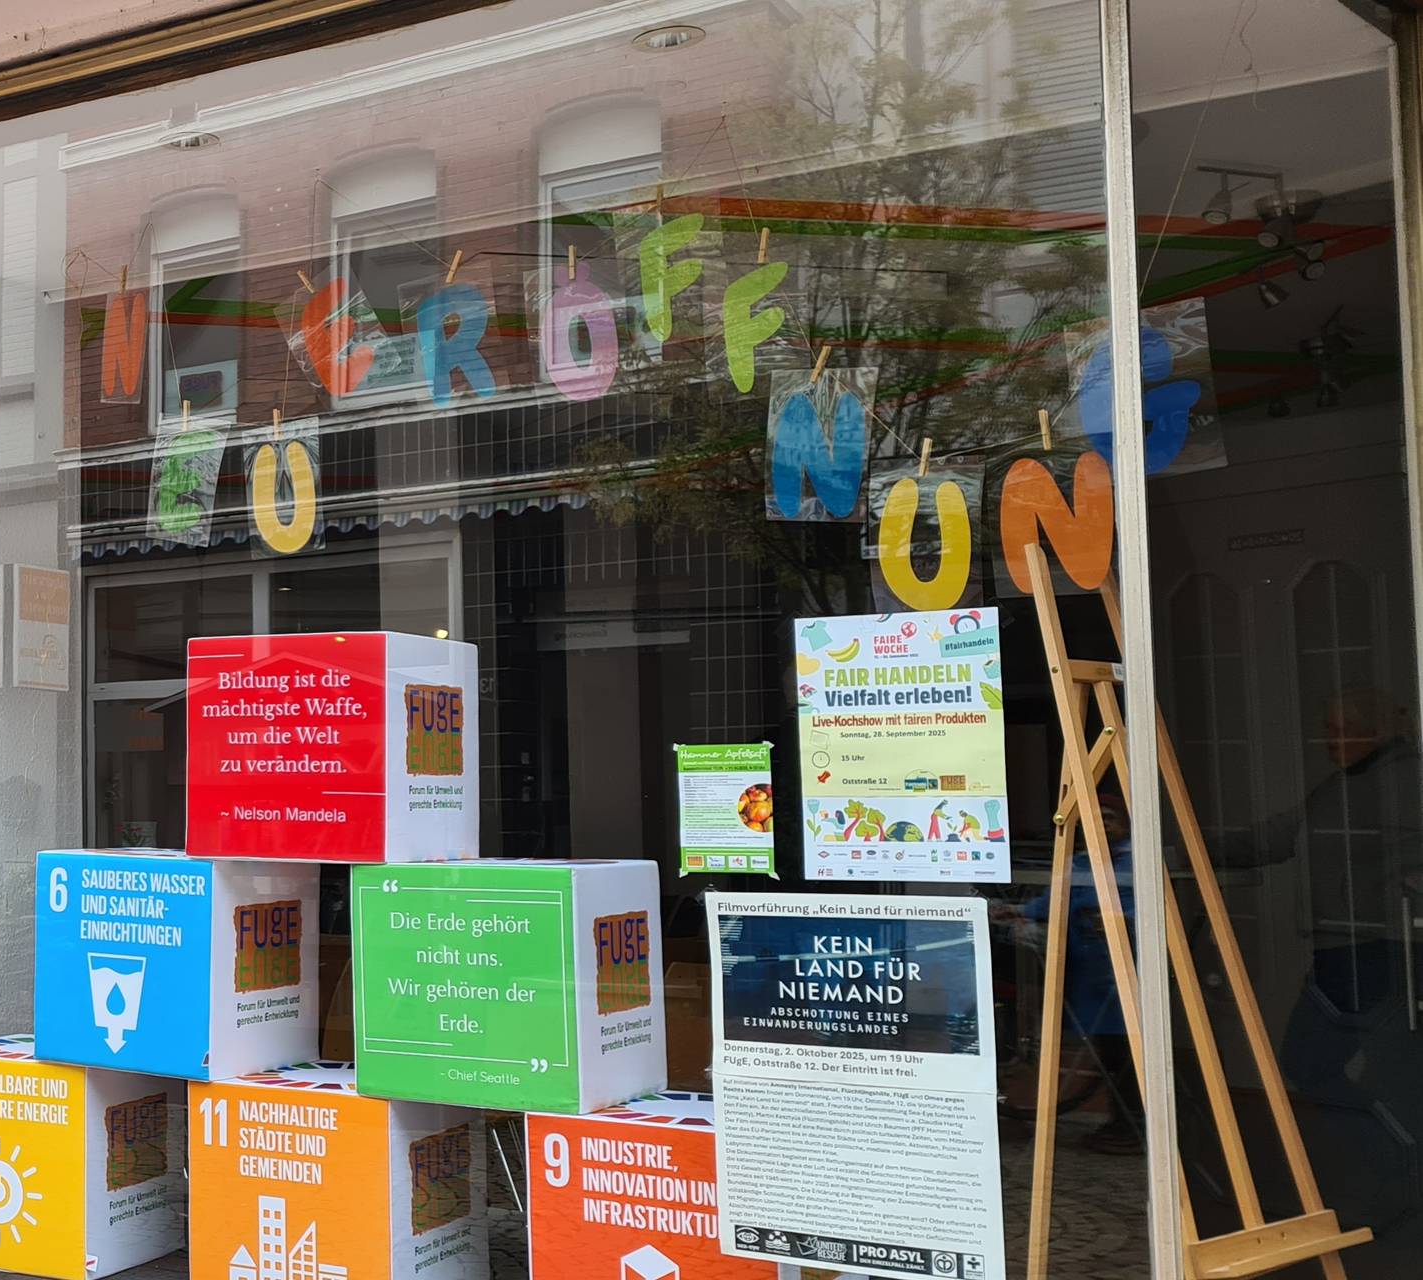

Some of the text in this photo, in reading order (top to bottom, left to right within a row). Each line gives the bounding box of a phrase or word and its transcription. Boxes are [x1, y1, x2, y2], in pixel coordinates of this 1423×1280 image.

[873, 635, 902, 645] FAIRE
[874, 644, 909, 654] WOCHE
[944, 638, 994, 651] #fairhandeln
[218, 671, 350, 692] Bildung ist die
[824, 663, 972, 687] FAIR HANDELN
[825, 685, 972, 708] Vielfalt erleben!
[202, 697, 367, 720] mächtigste Waffe,
[812, 712, 987, 728] Live-Kochshow mit fairen Produkten
[228, 726, 340, 745] um die Welt
[840, 731, 871, 739] Sonntag,
[886, 730, 926, 738] September
[220, 755, 347, 773] zu verändern.
[234, 807, 346, 822] Nelson Mandela
[49, 867, 205, 913] 6 SAUBERES WASSER
[81, 894, 169, 919] UND SANITÄR-
[718, 902, 972, 918] Filmvorführung „Kein Land für niemand“
[80, 920, 182, 947] EINRICHTUNGEN
[390, 912, 530, 937] Die Erde gehört
[814, 935, 873, 955] KEIN
[416, 946, 503, 966] nicht uns.
[795, 957, 921, 981] LAND FÜR
[388, 977, 535, 1003] Wir gehören der
[778, 981, 904, 1005] NIEMAND
[237, 994, 300, 1012] Forum für Umwelt und
[236, 1008, 298, 1028] gerechte Entwicklung
[439, 1014, 484, 1034] Erde.
[770, 1006, 909, 1023] ABSCHOTTUNG EINES
[744, 1017, 899, 1035] EINWANDERUNGSLANDES
[724, 1043, 924, 1064] Donnerstag, 2. Oktober 2025, um 19 Uhr
[447, 1068, 520, 1085] Chief Seattle
[753, 1058, 802, 1070] Oststraße
[804, 1062, 819, 1071] 12.
[821, 1063, 840, 1072] Der
[842, 1064, 878, 1075] Eintritt
[880, 1066, 896, 1076] ist
[896, 1067, 918, 1077] frei.
[41, 1078, 68, 1100] UND
[17, 1102, 69, 1126] ENERGIE
[199, 1097, 227, 1147] 11
[238, 1099, 337, 1131] NACHHALTIGE
[239, 1126, 326, 1157] STÄDTE UND
[239, 1155, 321, 1185] GEMEINDEN
[543, 1132, 679, 1188] 9 INDUSTRIE,
[582, 1168, 717, 1207] INNOVATION UN
[583, 1198, 720, 1240] INFRASTRUKTU
[859, 1245, 887, 1258] PRO
[889, 1248, 925, 1263] ASYL
